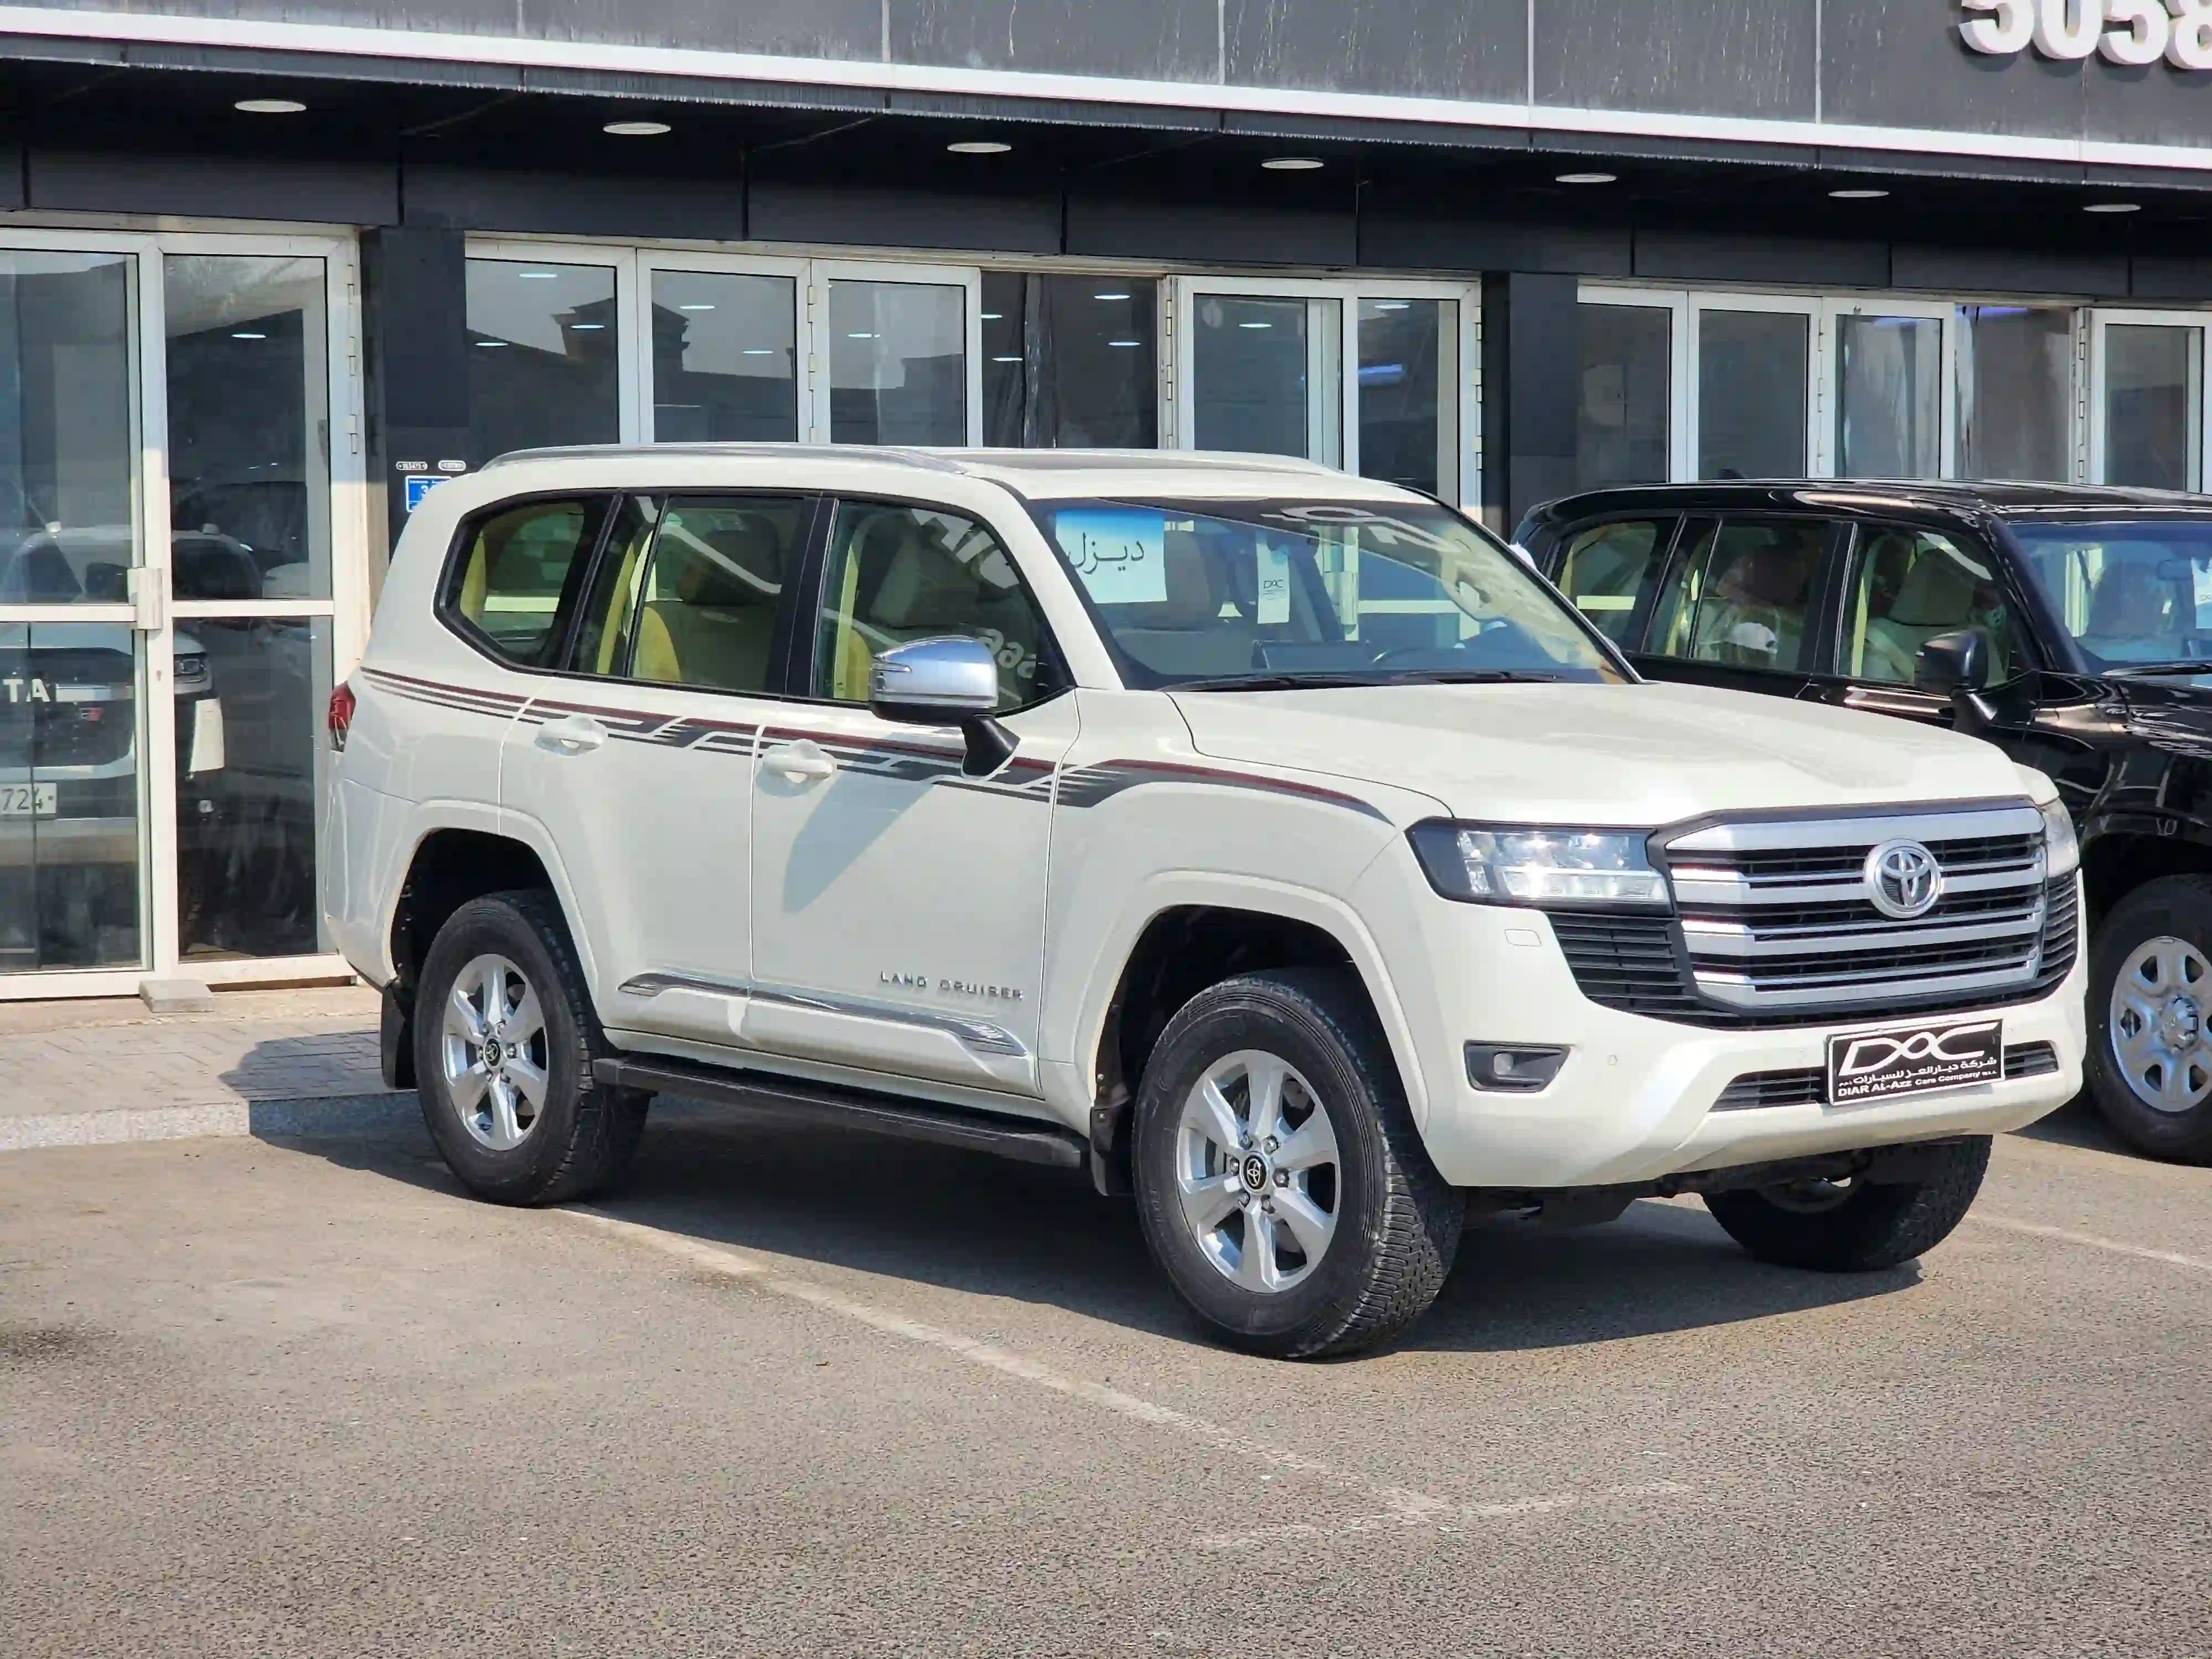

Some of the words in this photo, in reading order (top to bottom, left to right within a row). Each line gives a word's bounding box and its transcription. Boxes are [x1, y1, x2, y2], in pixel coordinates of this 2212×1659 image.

[1068, 531, 1144, 574] ديزل
[880, 971, 928, 988] LAND
[940, 979, 1024, 1001] CRUISER
[1960, 1056, 1997, 1069] شركة
[1838, 1084, 1869, 1097] DIAR
[1938, 1071, 1981, 1082] Company
[1853, 1070, 1904, 1084] للسيارات
